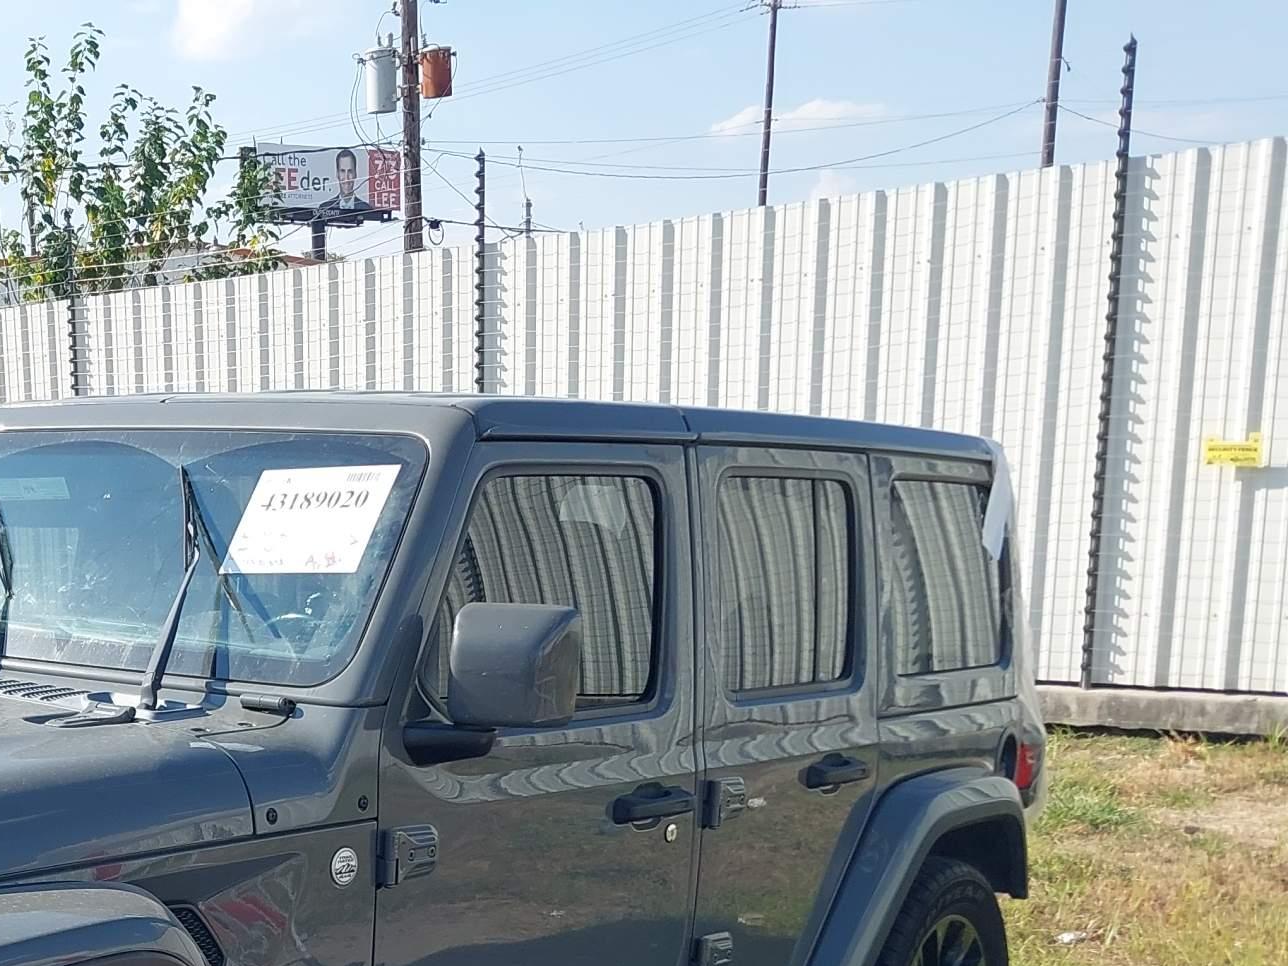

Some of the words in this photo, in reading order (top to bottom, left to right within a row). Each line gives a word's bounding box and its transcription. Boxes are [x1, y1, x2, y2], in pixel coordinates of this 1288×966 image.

[288, 153, 307, 166] the
[374, 180, 396, 190] CALL
[374, 192, 397, 207] LEE
[260, 490, 370, 512] 43189020
